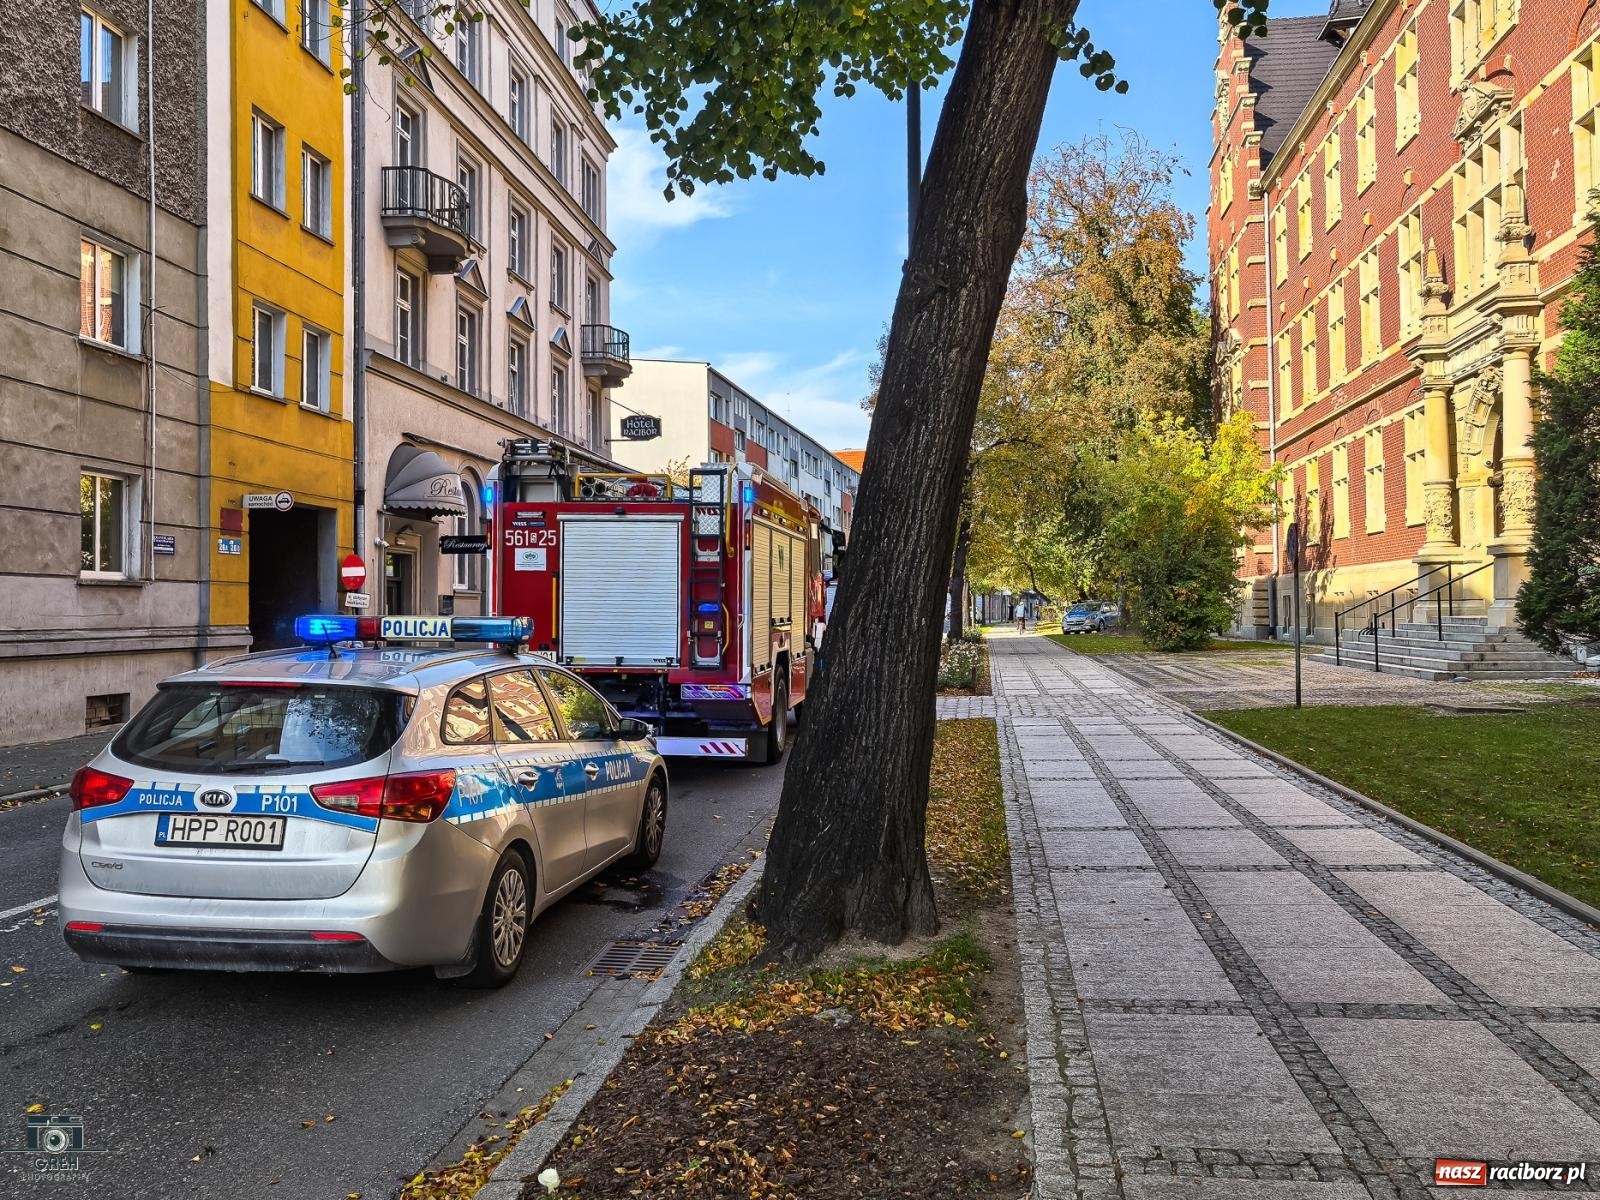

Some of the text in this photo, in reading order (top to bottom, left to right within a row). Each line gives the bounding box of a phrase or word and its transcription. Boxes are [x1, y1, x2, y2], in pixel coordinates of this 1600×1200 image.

[383, 620, 449, 637] POLICJA
[605, 759, 632, 782] POLICJA
[139, 793, 298, 812] POLICJA KIA P101
[171, 817, 218, 841] HPP
[225, 819, 278, 843] R001
